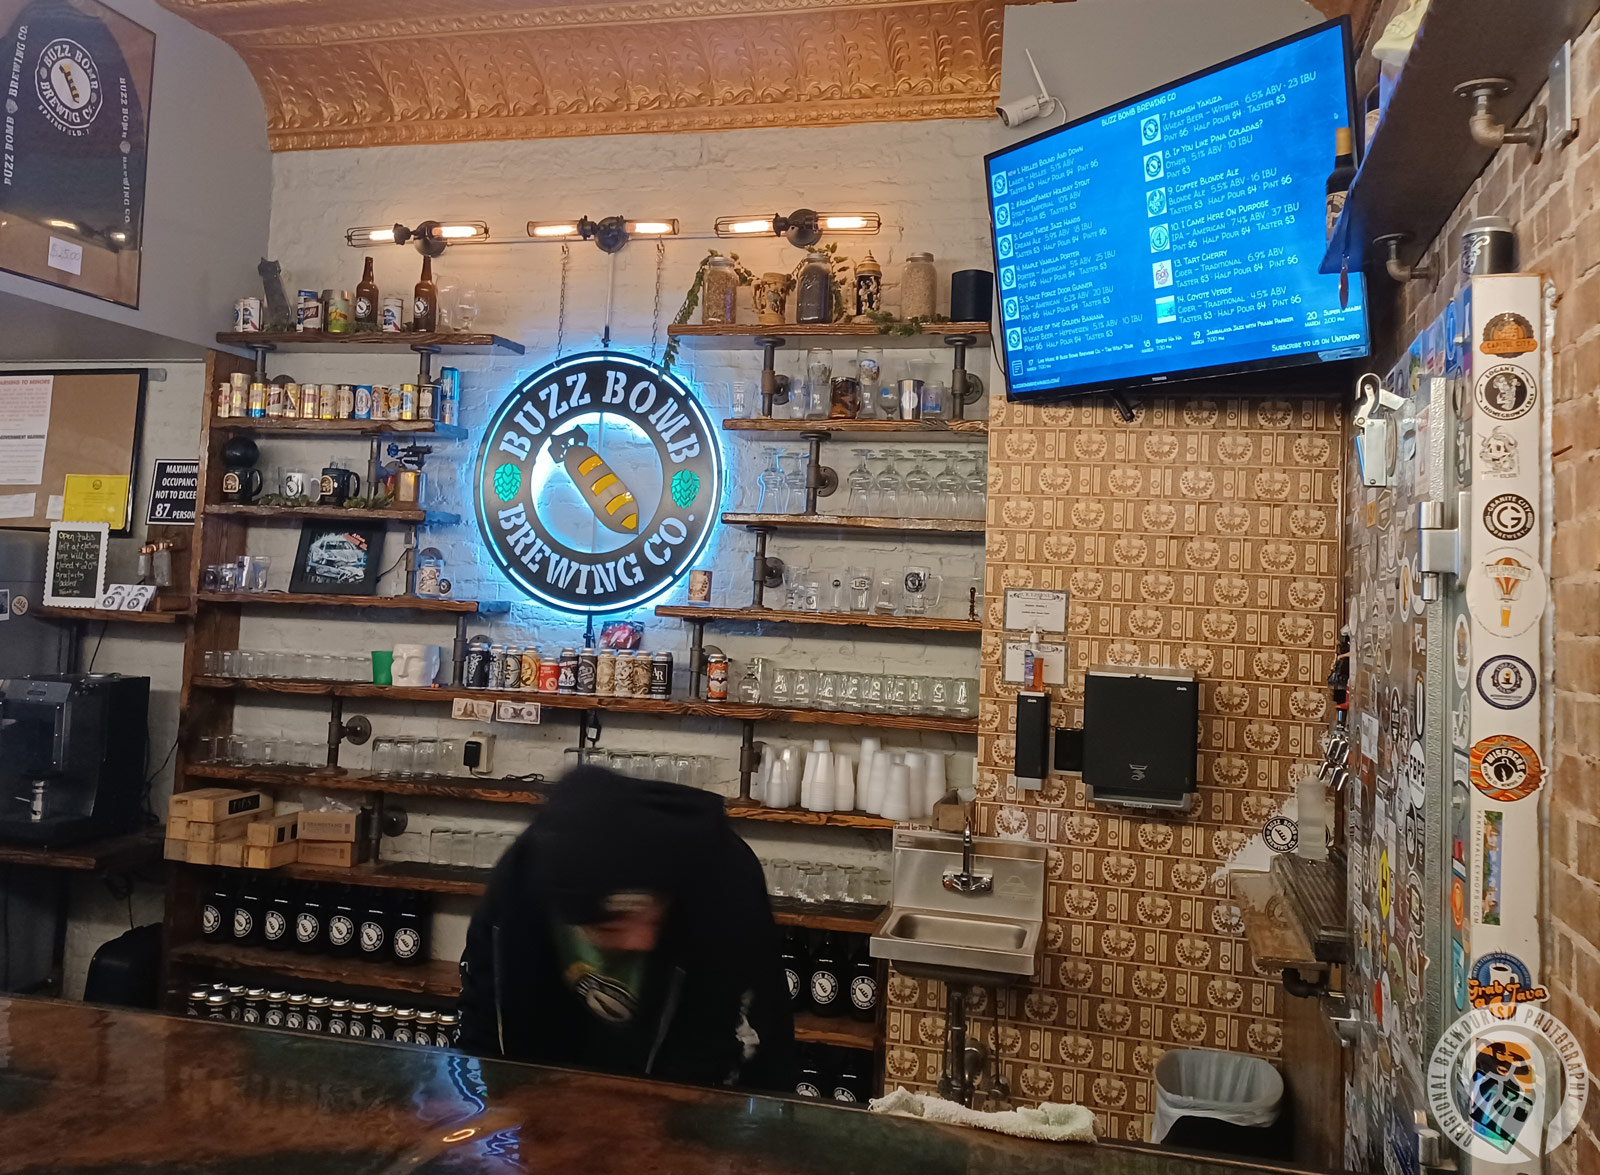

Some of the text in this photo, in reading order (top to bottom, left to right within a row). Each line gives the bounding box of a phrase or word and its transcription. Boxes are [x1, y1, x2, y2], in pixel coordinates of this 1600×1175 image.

[18, 25, 28, 40] CO.
[44, 44, 71, 68] BUZZ
[8, 42, 26, 97] BREWING
[1101, 90, 1177, 127] BUZZ BOMB BREWING CO
[1162, 119, 1184, 132] WHEAT
[1186, 112, 1203, 123] BEER
[1244, 89, 1262, 103] 6.5%
[1265, 82, 1281, 95] ABV
[1287, 76, 1298, 88] 23
[1300, 70, 1316, 84] IBU
[1162, 94, 1222, 121] 7. FLEMISH YAKUZA
[1163, 93, 1286, 142] PINT $6 HALF POUR $4 TASTER $3
[5, 116, 14, 150] BOMB
[1164, 118, 1263, 158] 8. IF YOU LIKE PINA COLADAS?
[1166, 165, 1190, 179] PINT $3
[1167, 168, 1238, 194] 9. COFFEE BLONDE ALE
[1170, 222, 1179, 231] 10.
[1186, 217, 1205, 227] CAME
[1207, 212, 1223, 222] HERE
[1226, 208, 1236, 217] ON
[1238, 200, 1268, 214] PURPOSE
[1173, 249, 1227, 267] 13. TART CHERRY
[1174, 246, 1283, 277] CIDER TRADITIONAL 6.9% ABV
[1176, 287, 1232, 303] 14. COYOTE VERDE
[1178, 286, 1286, 313] CIDER TRADITIONAL 4.5% ABV
[1179, 314, 1202, 323] TASTER
[1203, 311, 1212, 320] $3
[1236, 305, 1254, 313] POUR
[1256, 301, 1266, 310] $4
[1272, 299, 1288, 307] PINT
[1290, 294, 1301, 304] $6
[1306, 311, 1317, 320] 20
[1271, 334, 1360, 351] SUBSCRIBE TO US ON UNTAPPD
[499, 370, 700, 464] BUZZ BOMB
[166, 465, 198, 473] MAXIMUM
[155, 490, 197, 499] NOT TO EXCEE
[1488, 495, 1532, 512] GRANITE CITY
[155, 503, 171, 517] 87
[172, 511, 196, 519] PERSON
[1493, 529, 1525, 539] BREWERY
[498, 502, 695, 594] BREWING CO.
[1468, 980, 1504, 1000] Grab
[1474, 999, 1485, 1008] a
